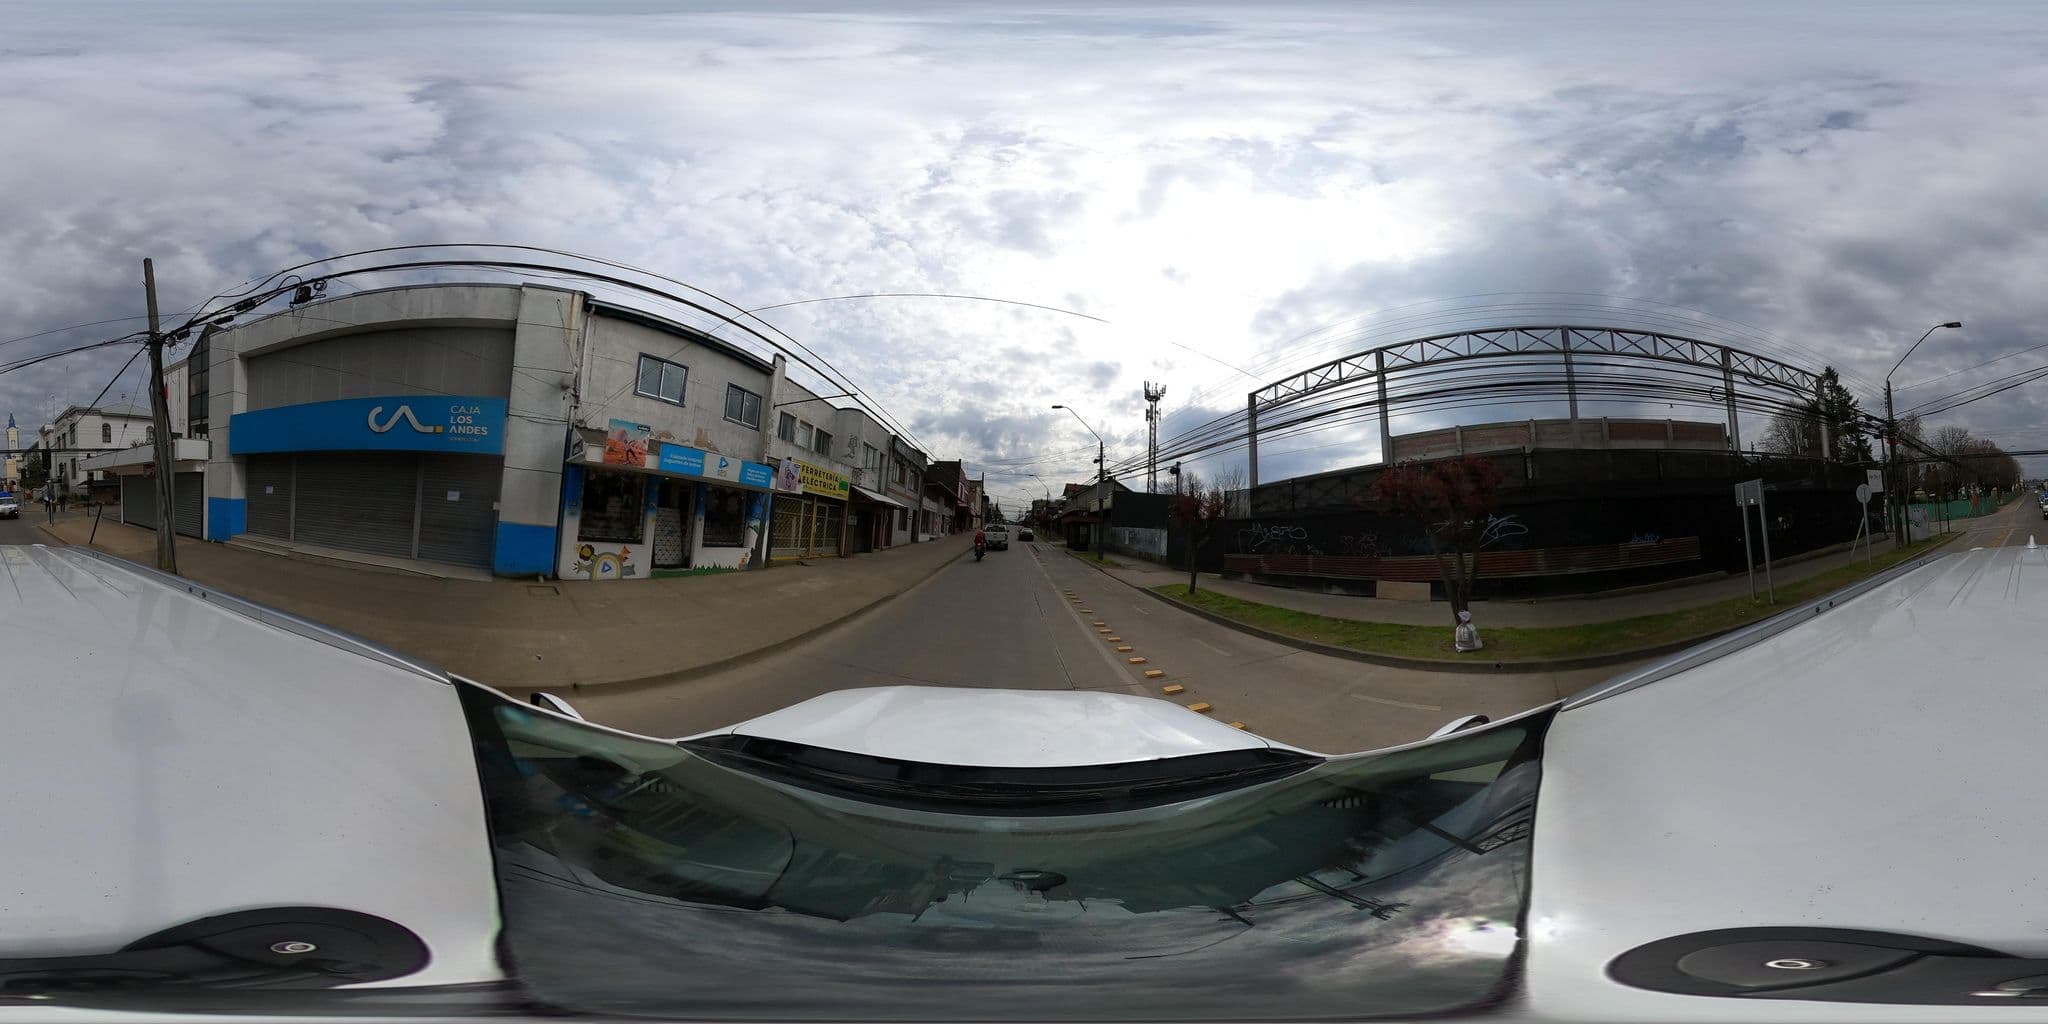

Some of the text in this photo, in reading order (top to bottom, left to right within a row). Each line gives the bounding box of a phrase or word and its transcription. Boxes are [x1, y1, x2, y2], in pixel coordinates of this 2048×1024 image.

[450, 405, 481, 415] CAJA
[450, 415, 473, 424] LOS
[449, 425, 489, 436] ANDES
[802, 476, 837, 490] ELECTRICA
